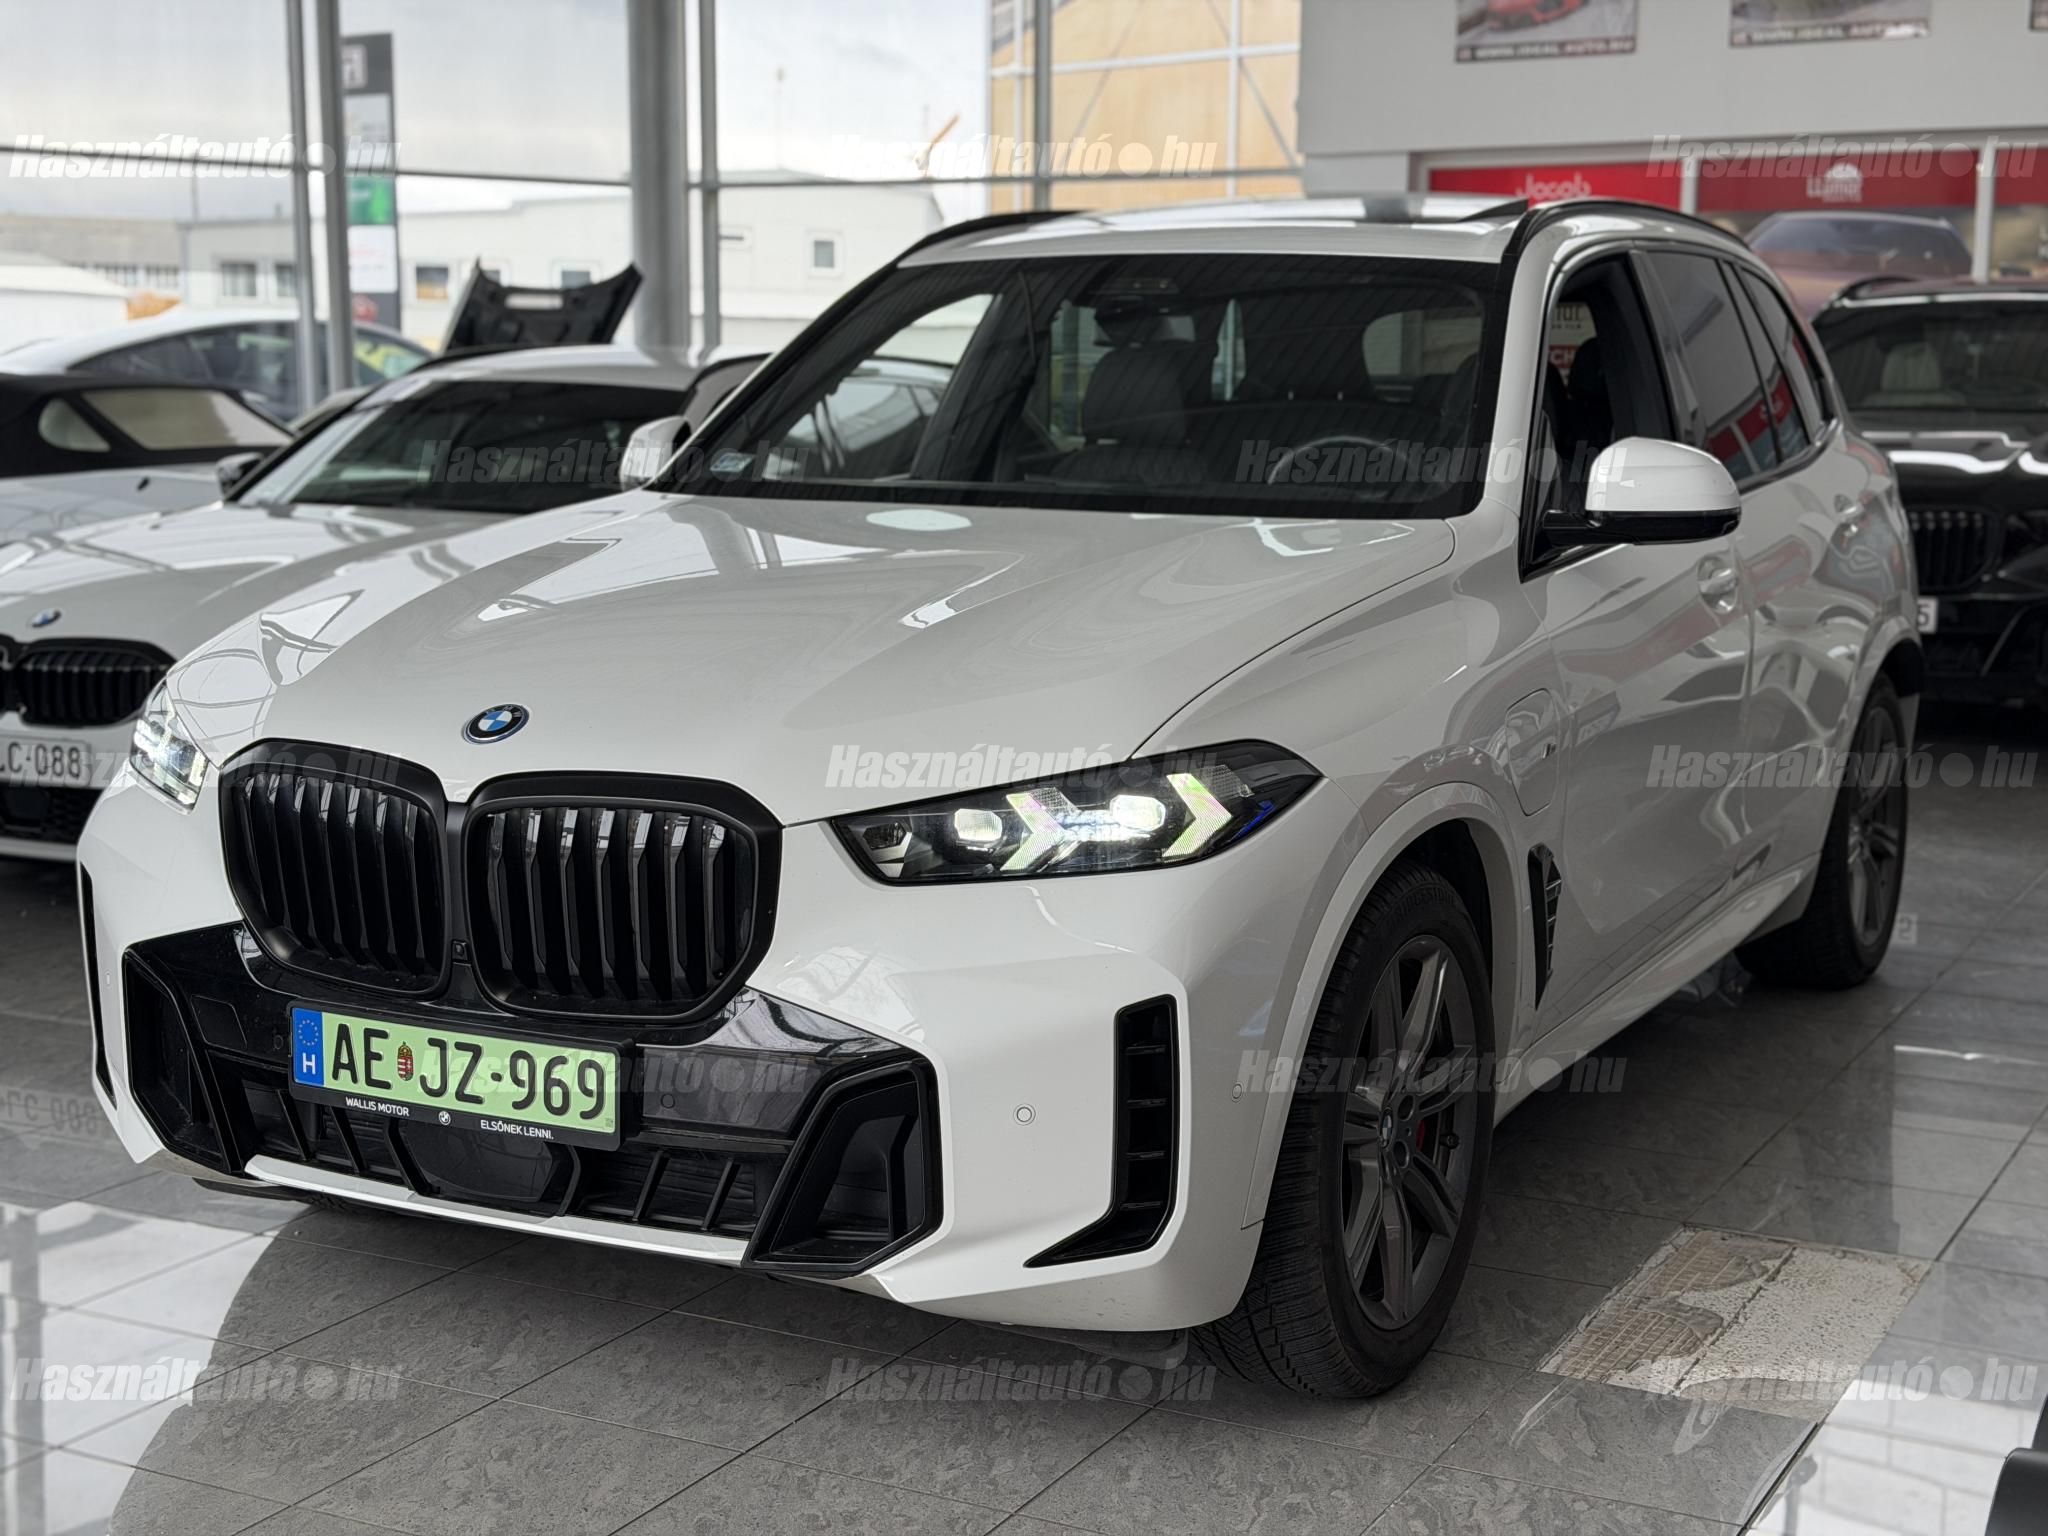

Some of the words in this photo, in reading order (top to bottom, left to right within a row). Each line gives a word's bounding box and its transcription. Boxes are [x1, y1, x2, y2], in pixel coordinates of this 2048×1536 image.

[303, 1052, 316, 1075] H
[332, 1023, 392, 1090] AE
[345, 1096, 377, 1111] WALLIS
[377, 1102, 410, 1117] MOTOR
